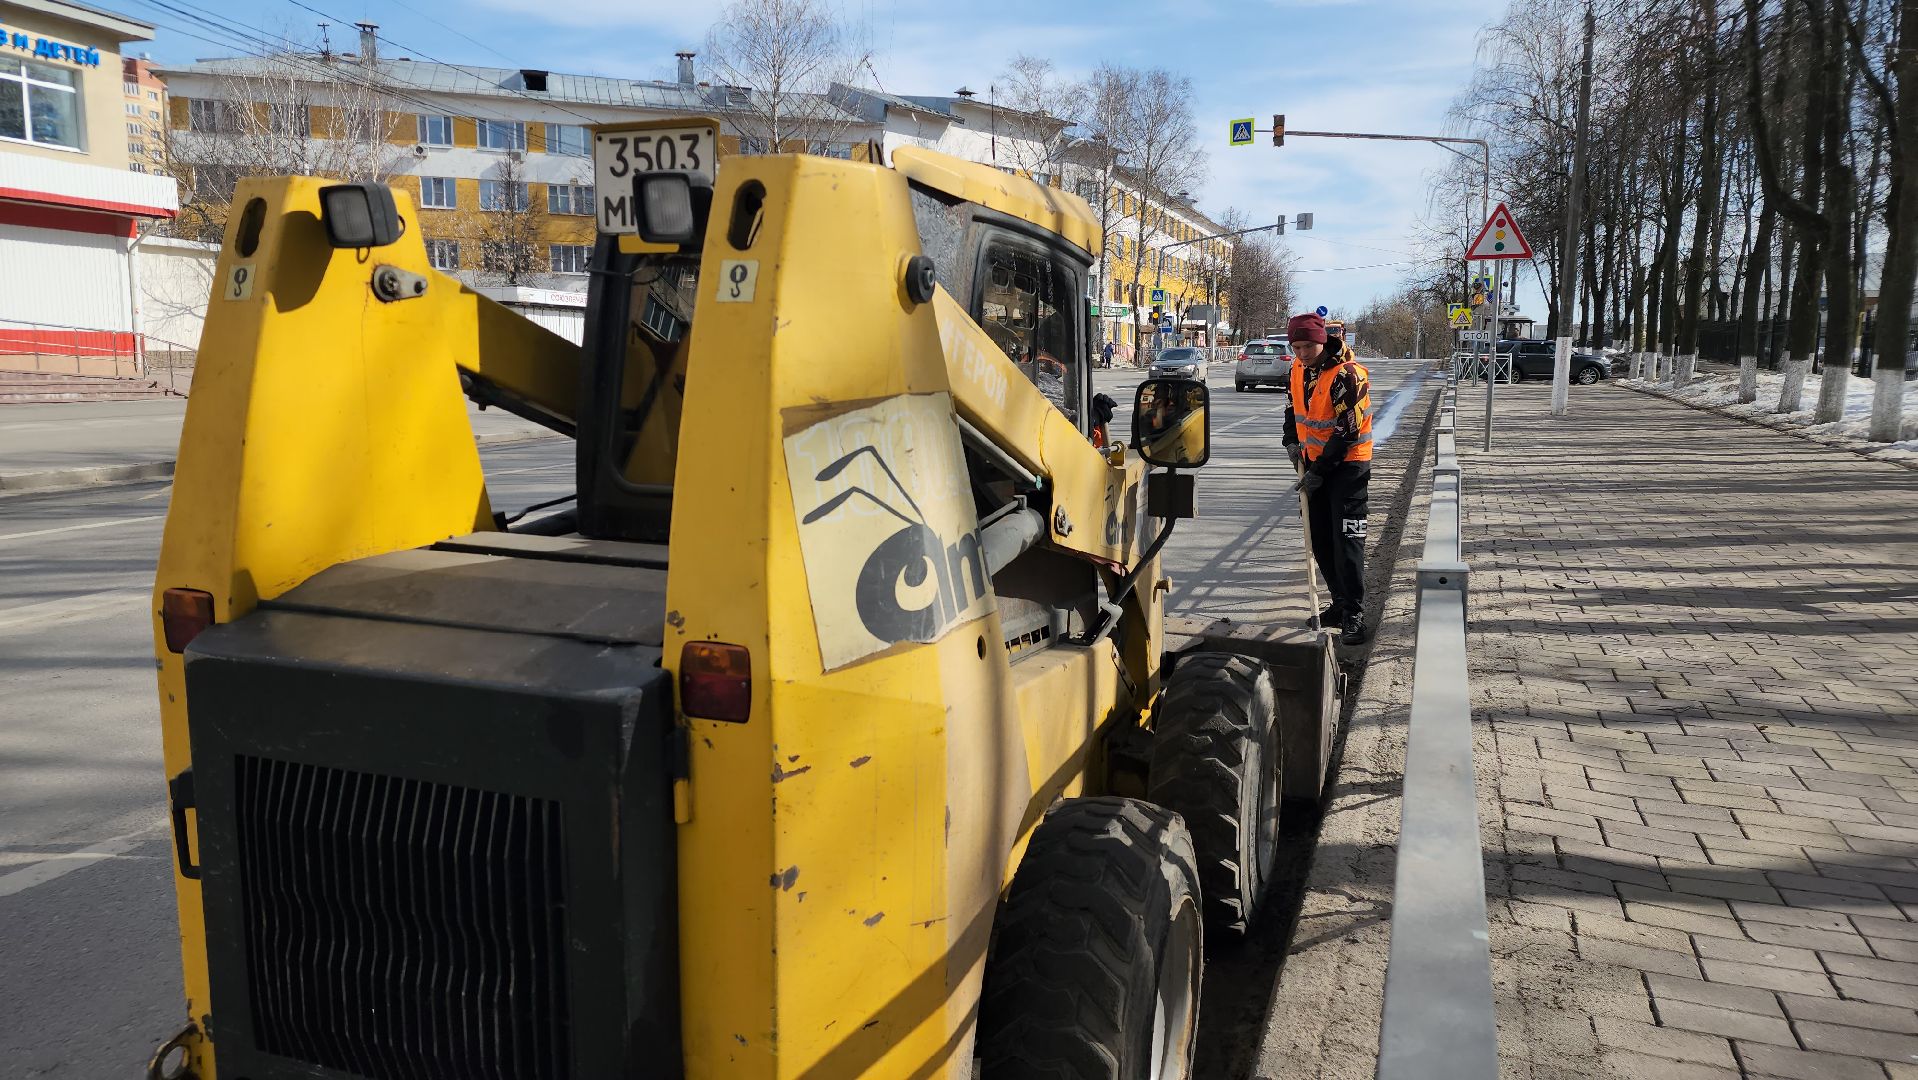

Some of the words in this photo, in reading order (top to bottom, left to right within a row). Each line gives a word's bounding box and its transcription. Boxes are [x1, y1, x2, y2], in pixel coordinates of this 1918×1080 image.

[13, 32, 28, 49] И
[34, 37, 100, 66] ДЕТЕЙ
[608, 134, 700, 177] 3503
